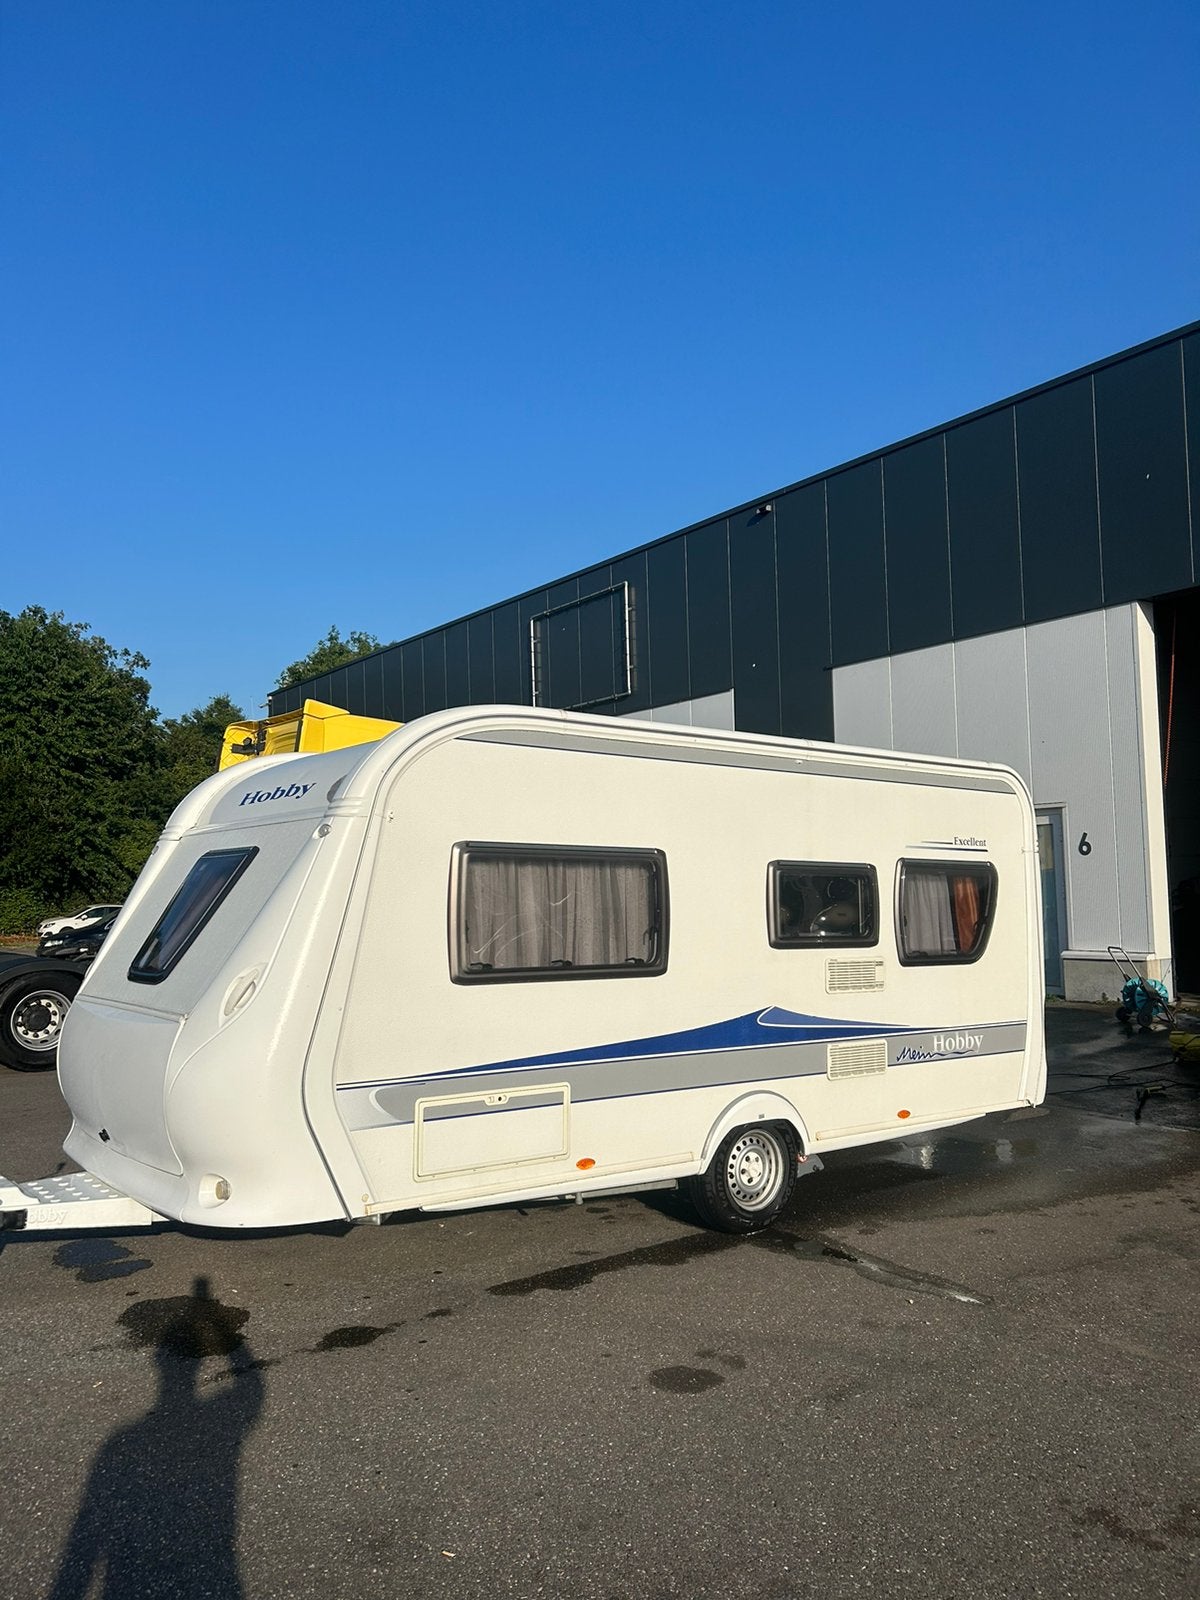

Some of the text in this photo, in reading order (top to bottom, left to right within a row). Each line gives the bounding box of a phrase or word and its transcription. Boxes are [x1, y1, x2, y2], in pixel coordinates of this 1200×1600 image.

[239, 782, 316, 806] Hobby
[953, 836, 987, 847] Excellent
[1078, 831, 1092, 856] 6
[932, 1030, 984, 1055] Hobby
[27, 1205, 69, 1226] obby
